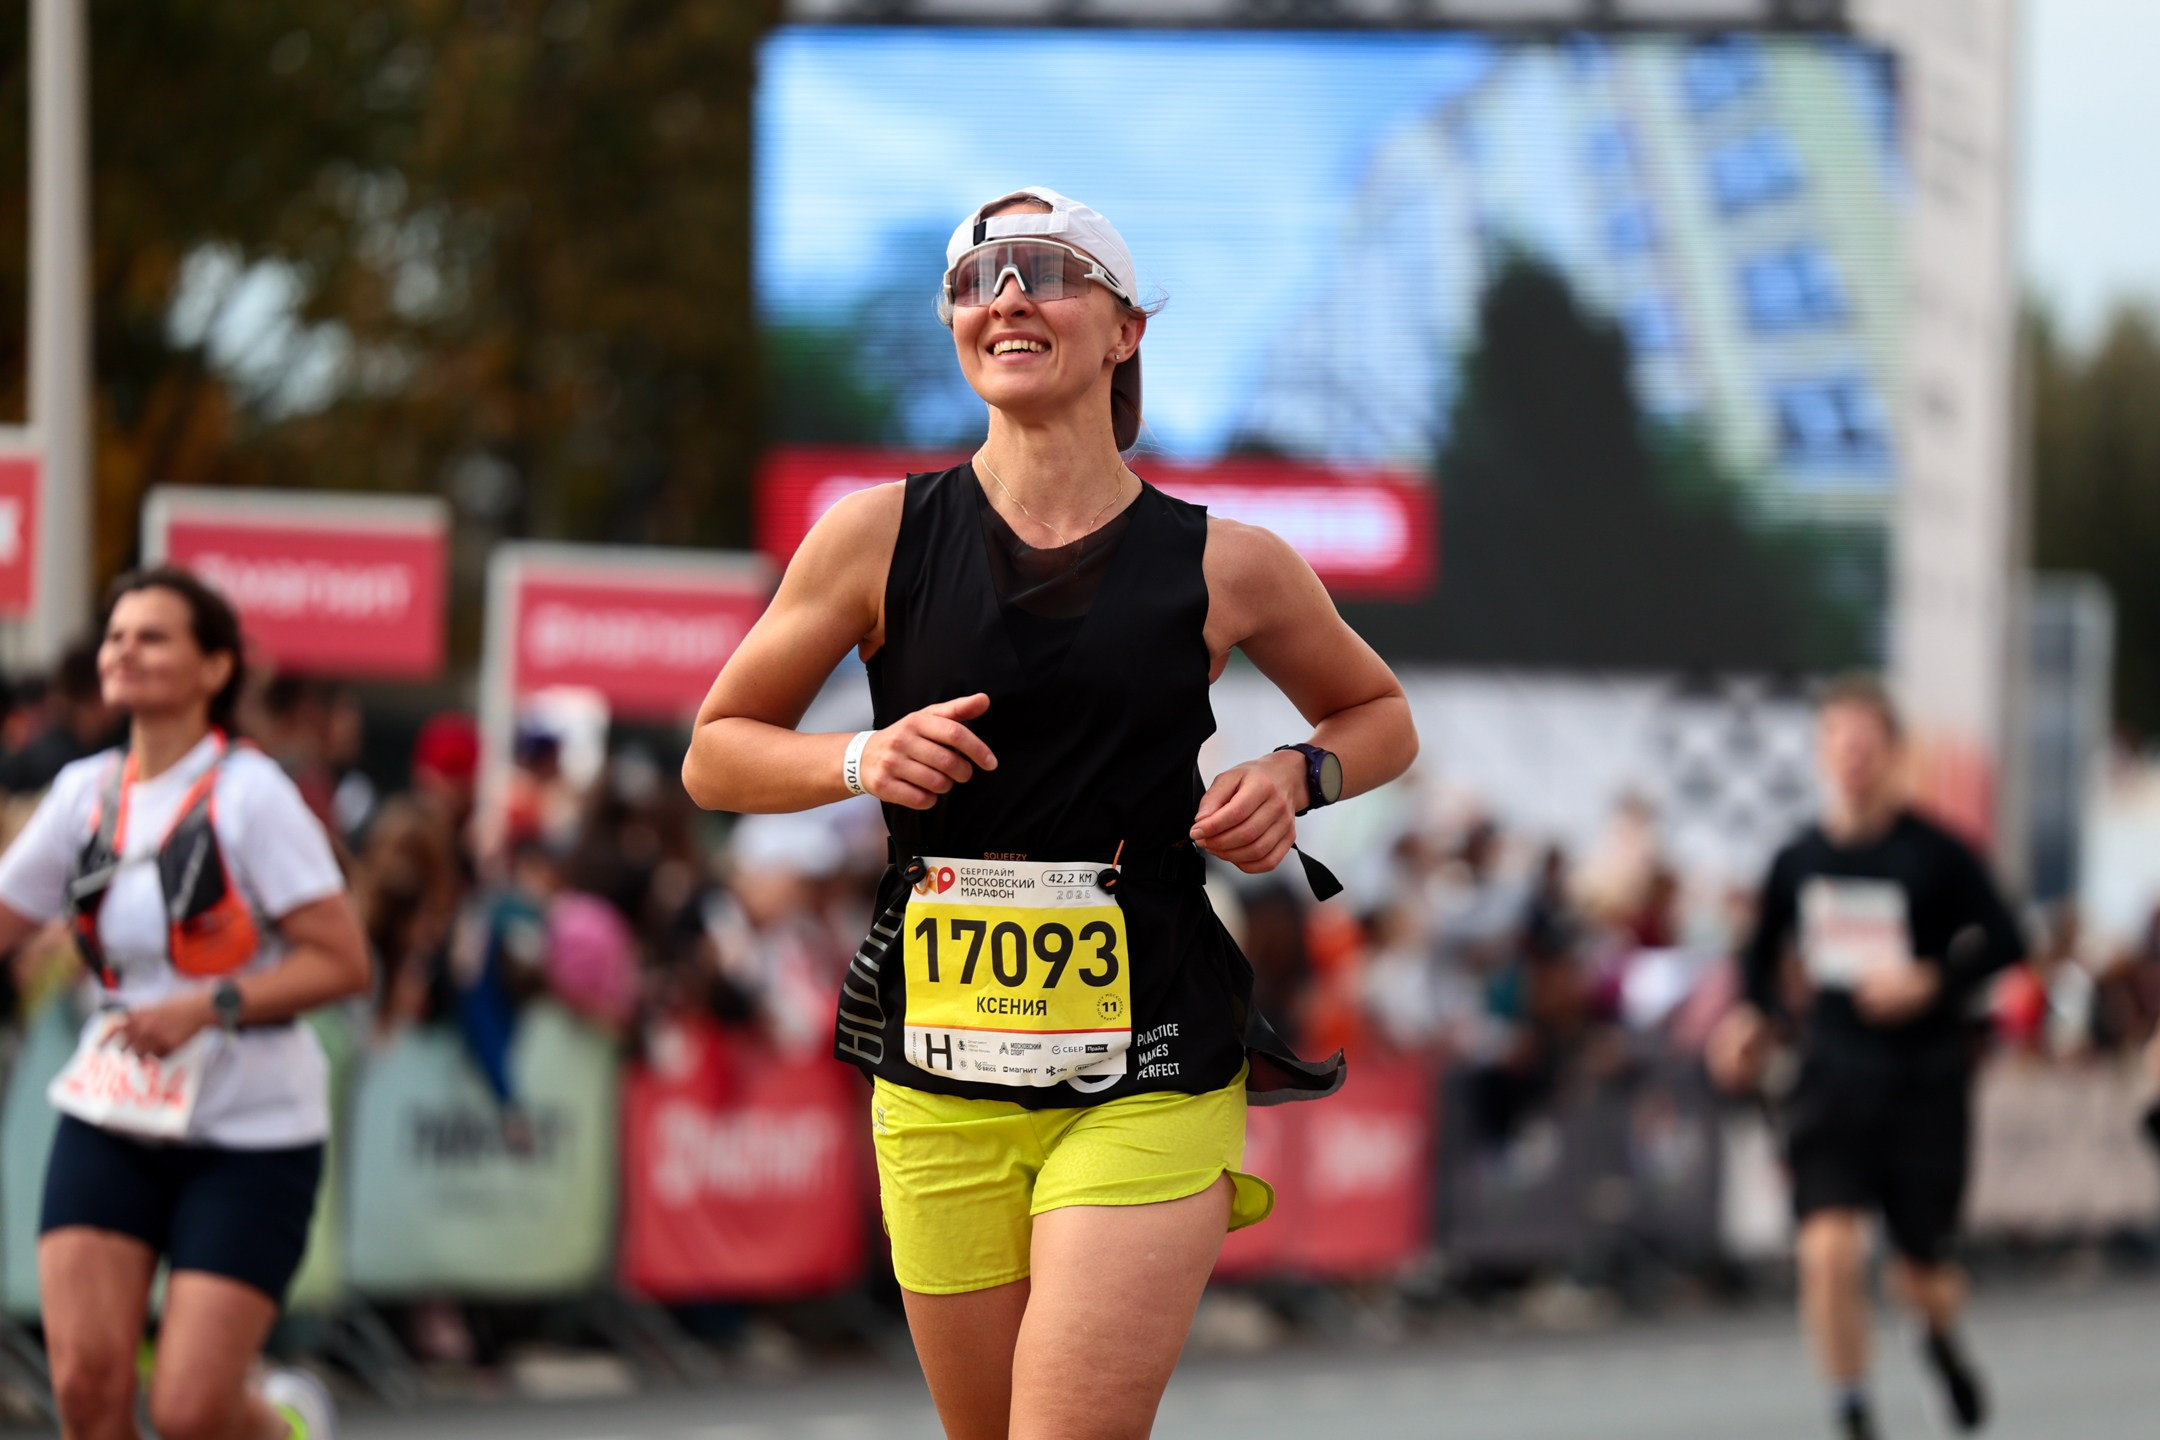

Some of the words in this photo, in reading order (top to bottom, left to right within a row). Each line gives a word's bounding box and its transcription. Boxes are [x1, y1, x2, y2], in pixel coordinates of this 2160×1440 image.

[960, 866, 1015, 877] СБЕРПРАЙМ
[960, 876, 1035, 889] МОСКОВСКИЙ
[1048, 873, 1075, 885] 42,2
[1078, 873, 1092, 883] КМ
[960, 887, 1015, 899] МАРАФОН
[915, 917, 1119, 989] 17093
[976, 996, 1048, 1016] КСЕНИЯ
[1102, 1001, 1117, 1012] 11
[1138, 1043, 1169, 1066] MAKES
[1136, 1062, 1180, 1081] PERFECT
